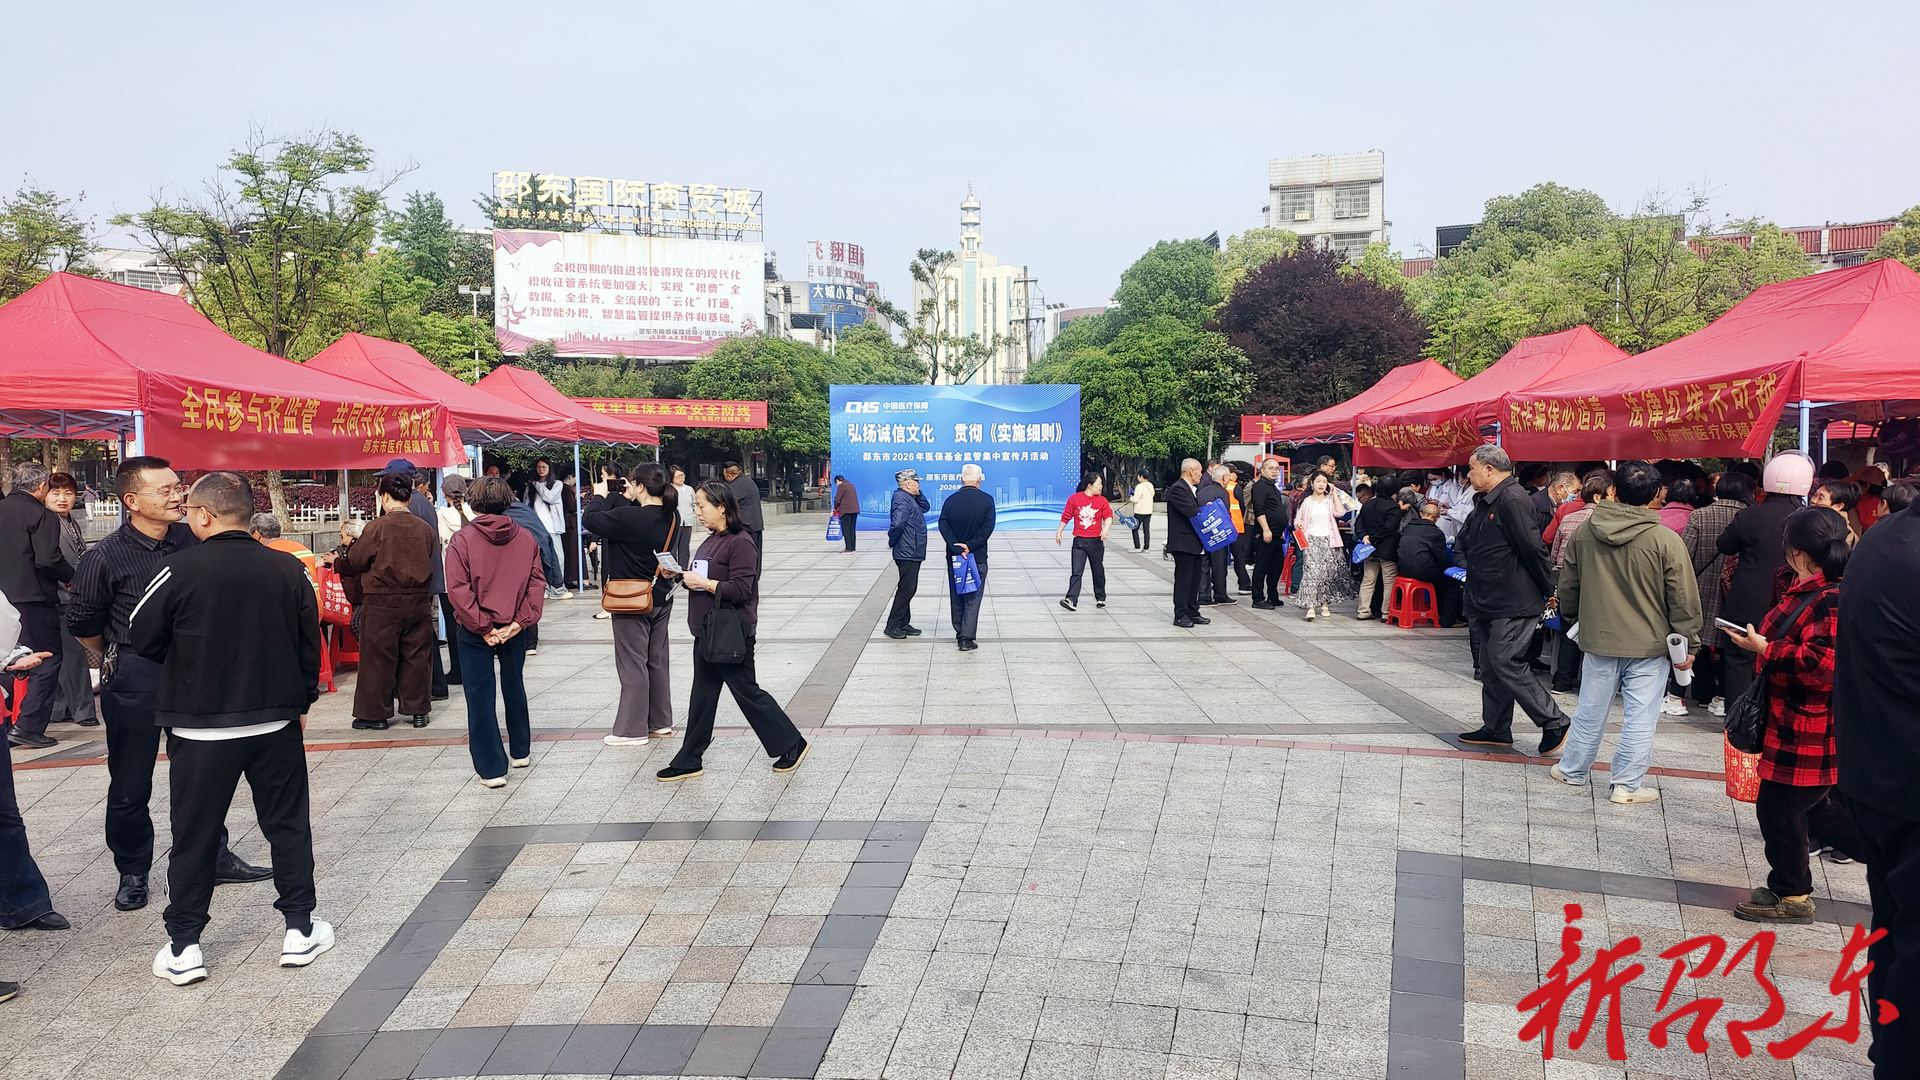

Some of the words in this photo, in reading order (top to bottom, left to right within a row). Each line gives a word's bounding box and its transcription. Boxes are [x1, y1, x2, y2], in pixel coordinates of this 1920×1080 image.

[496, 170, 757, 219] 邵东国际商贸城
[553, 261, 741, 280] 金税四期的推进将使得现在的现代化
[812, 284, 855, 301] 大城小爱
[529, 306, 735, 324] 为智能办税、智慧监管提供条件和基础。
[181, 386, 321, 436] 全民参与齐监管
[591, 402, 752, 418] 筑牢医保基金安全防线
[844, 401, 881, 414] CHS
[882, 401, 929, 410] 中国医疗保障
[1509, 395, 1607, 434] 欺诈骗保必追责
[1621, 372, 1777, 429] 法律红线不可越
[847, 423, 935, 444] 弘扬诚信文化
[953, 422, 1063, 443] 贯彻《实施细则》
[362, 438, 430, 454] 邵东市医疗保障局
[432, 440, 441, 454] 宣
[862, 451, 1049, 462] 邵东市2026年医保基金监管集中宣传月活动
